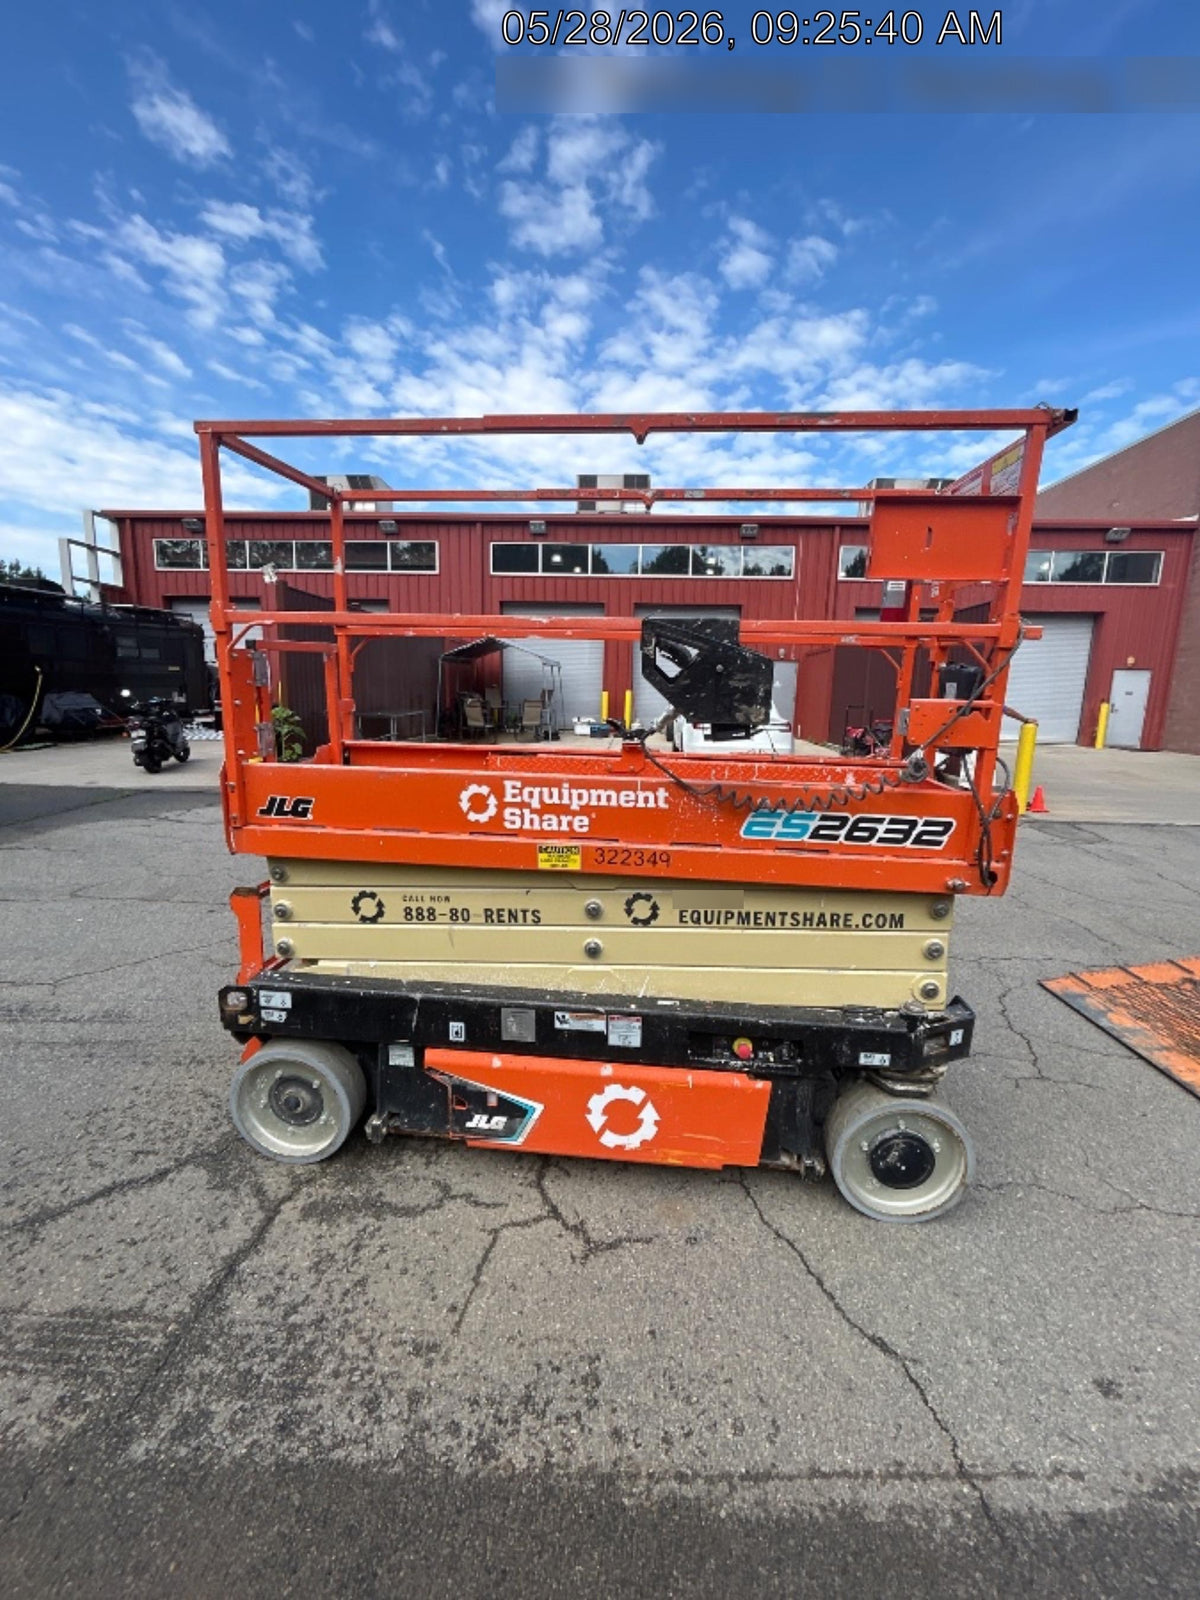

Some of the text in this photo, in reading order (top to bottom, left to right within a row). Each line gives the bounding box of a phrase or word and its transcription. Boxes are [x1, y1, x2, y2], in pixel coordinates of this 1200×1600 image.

[503, 780, 669, 810] Equipment
[257, 795, 315, 820] JLG
[503, 808, 589, 833] Share
[741, 811, 956, 850] ES2632
[594, 848, 671, 867] 322349
[430, 895, 450, 903] NOW
[678, 909, 905, 928] EQUIPMENTSHARE.COM
[465, 1114, 508, 1130] JLG
